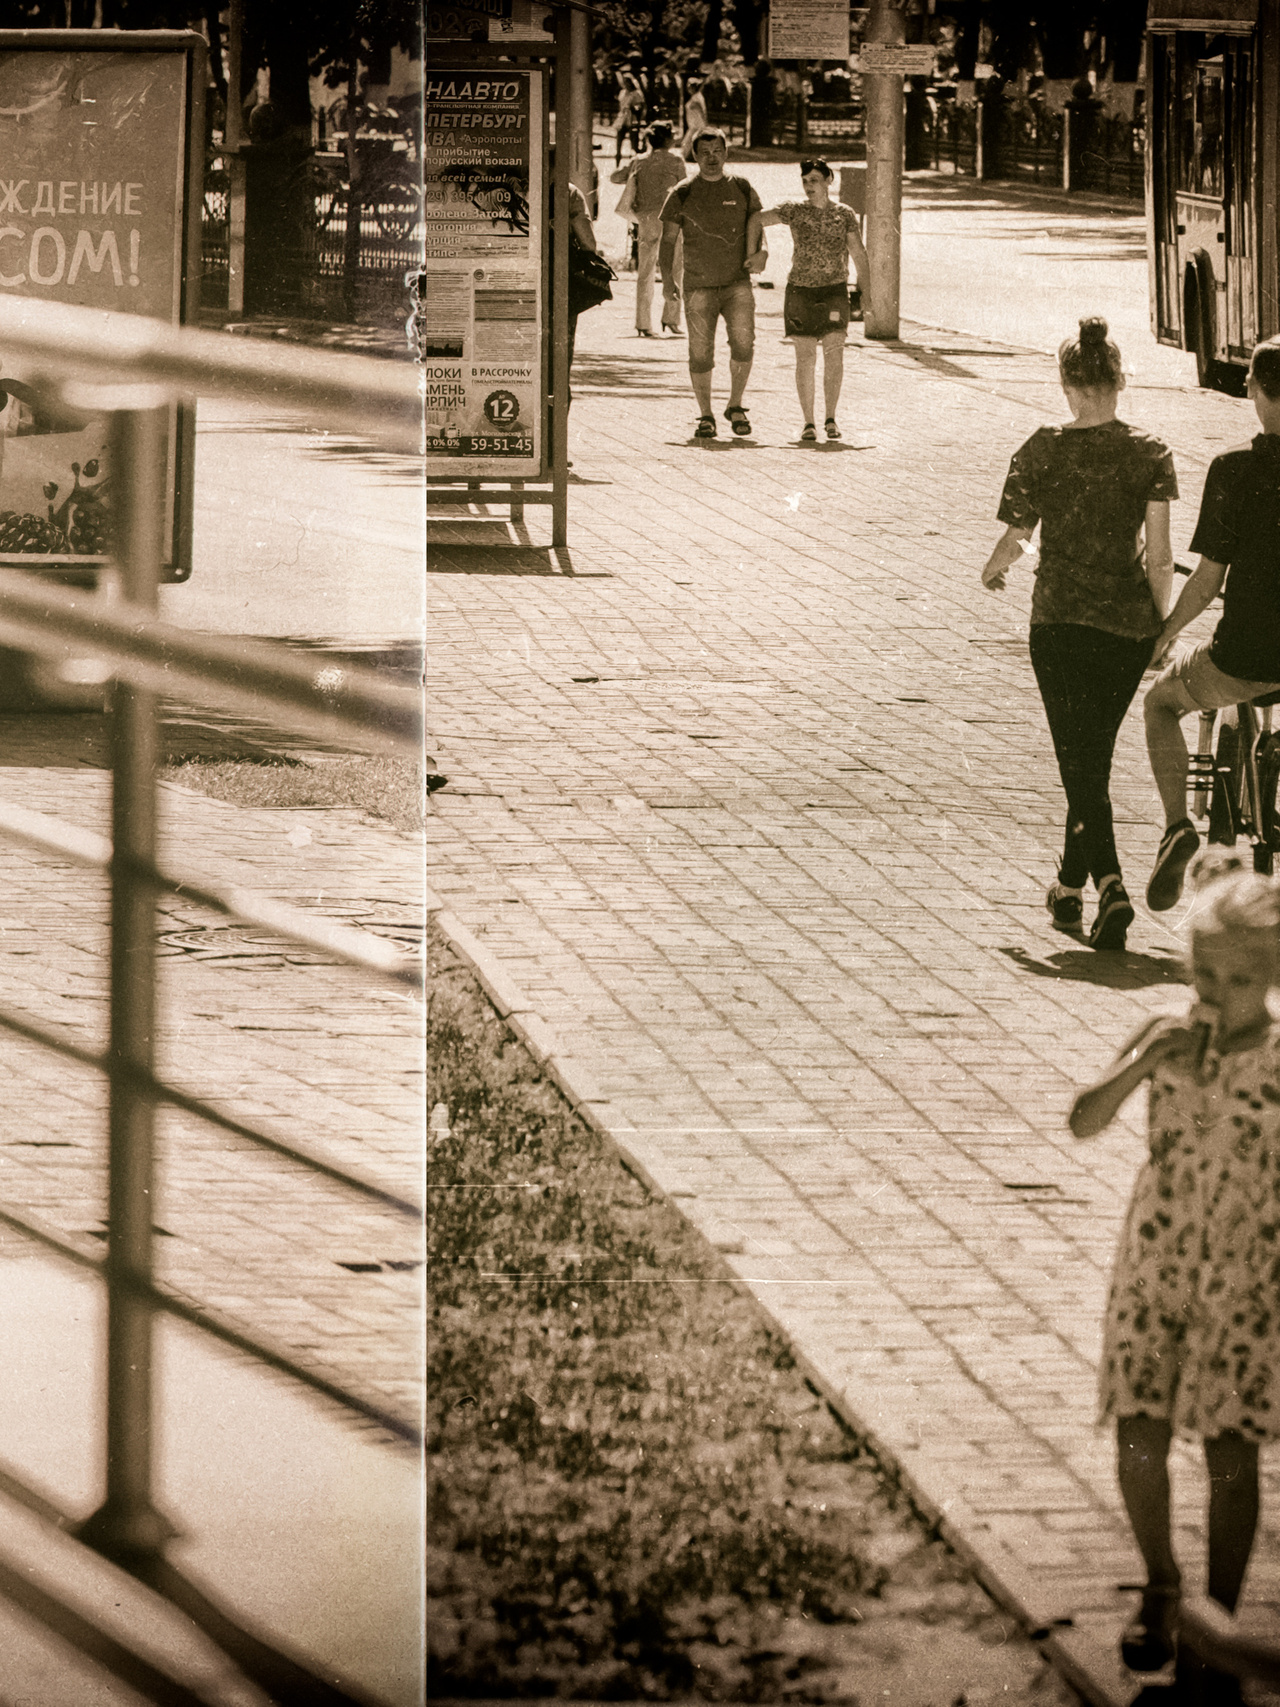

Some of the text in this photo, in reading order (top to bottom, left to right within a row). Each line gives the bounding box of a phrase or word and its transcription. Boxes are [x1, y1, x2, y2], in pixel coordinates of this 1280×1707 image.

[427, 113, 527, 129] ПЕТЕРБУРГ
[436, 147, 491, 158] прибытие
[484, 157, 523, 166] вокзал
[440, 173, 467, 182] всей
[468, 173, 507, 183] семьи!
[451, 190, 475, 203] 395
[496, 191, 512, 203] 09
[473, 209, 513, 219] Затока
[426, 223, 477, 233] ногория
[471, 368, 532, 378] В РАССРОЧКУ
[490, 399, 514, 418] 12
[447, 438, 460, 447] 0%
[470, 438, 532, 451] 59-51-45
